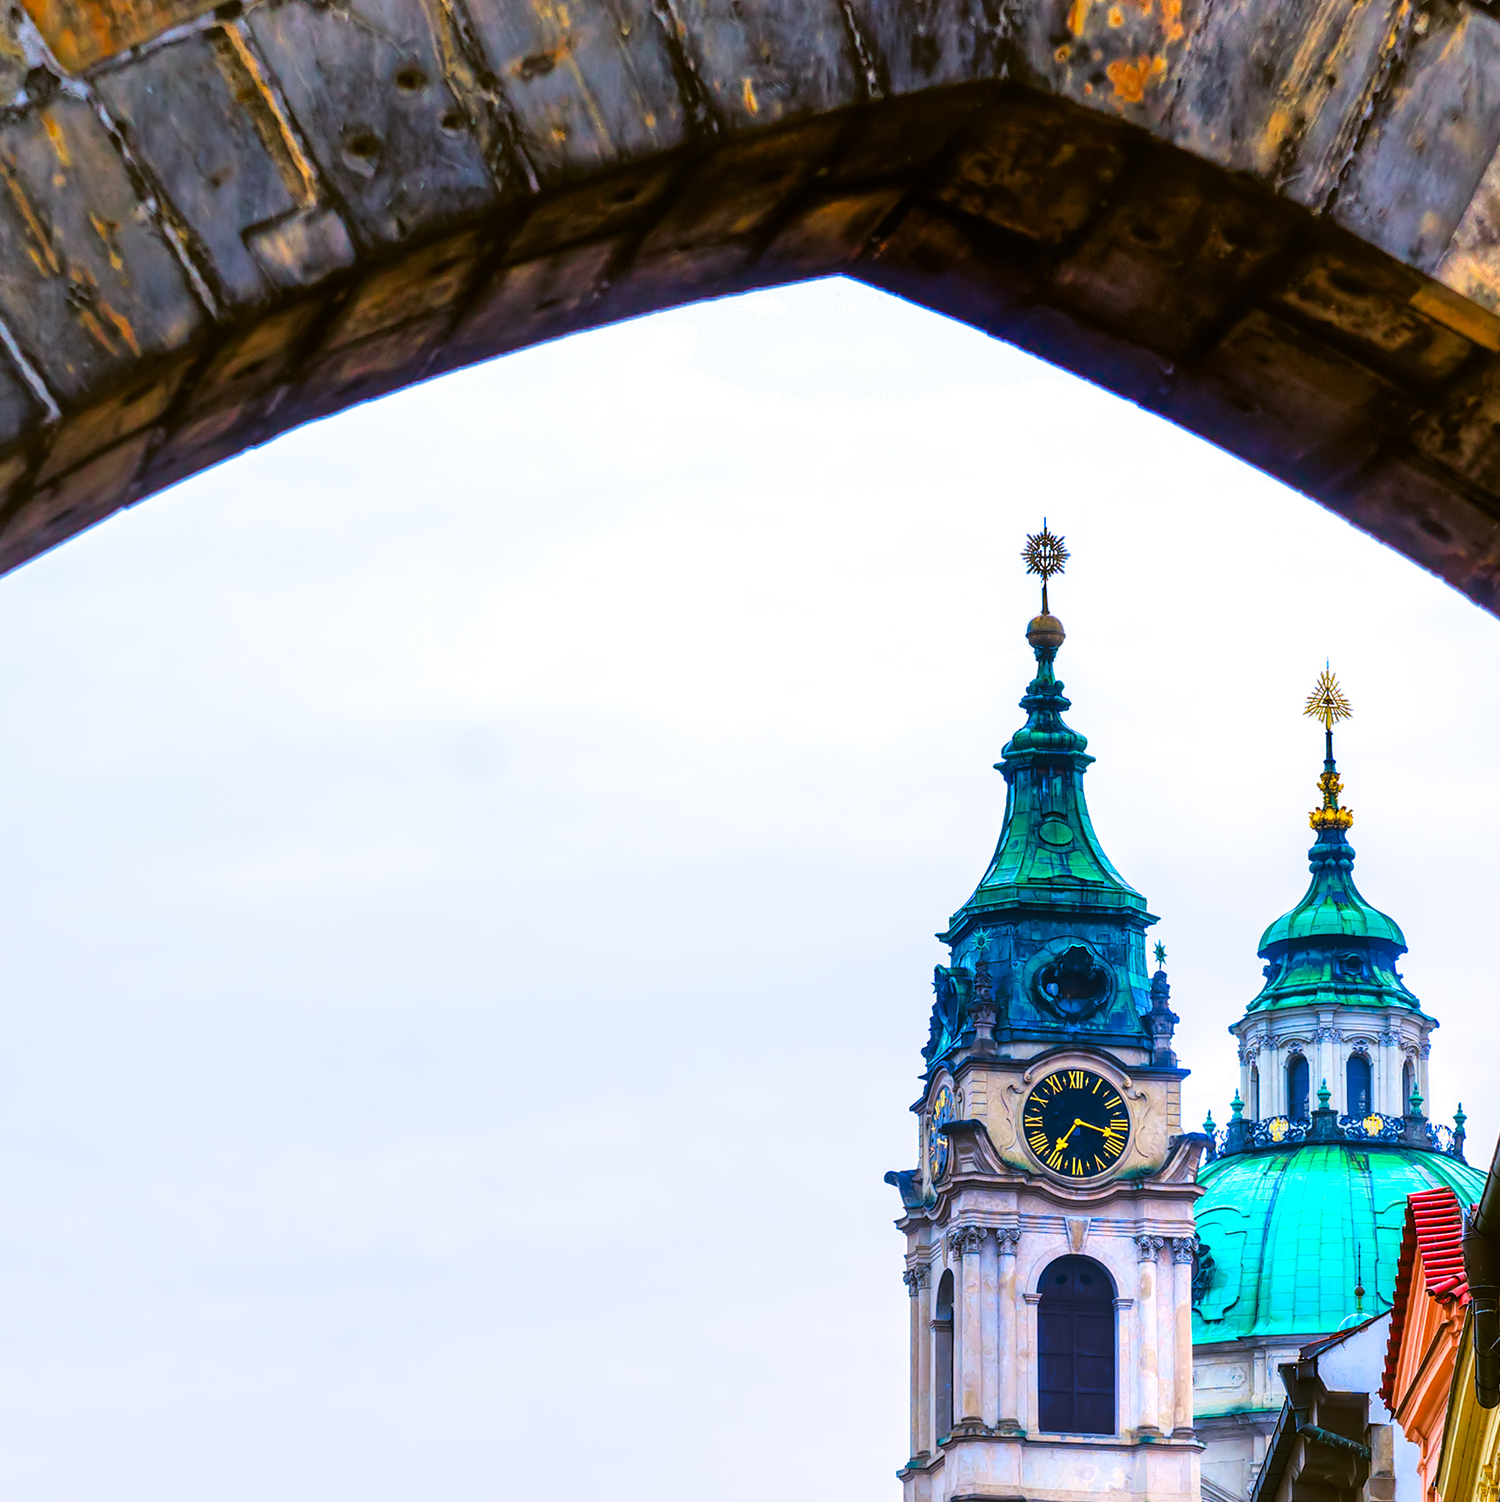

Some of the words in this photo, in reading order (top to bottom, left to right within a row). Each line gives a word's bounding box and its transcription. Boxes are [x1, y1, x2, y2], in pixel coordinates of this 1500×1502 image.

[1045, 1074, 1063, 1095] XI
[1068, 1071, 1084, 1089] XII
[1092, 1078, 1103, 1094] I
[1030, 1092, 1049, 1108] X
[1104, 1096, 1122, 1109] II
[1024, 1114, 1043, 1127] IX
[1110, 1119, 1128, 1131] III
[1071, 1157, 1084, 1175] VI
[1094, 1153, 1107, 1171] V
